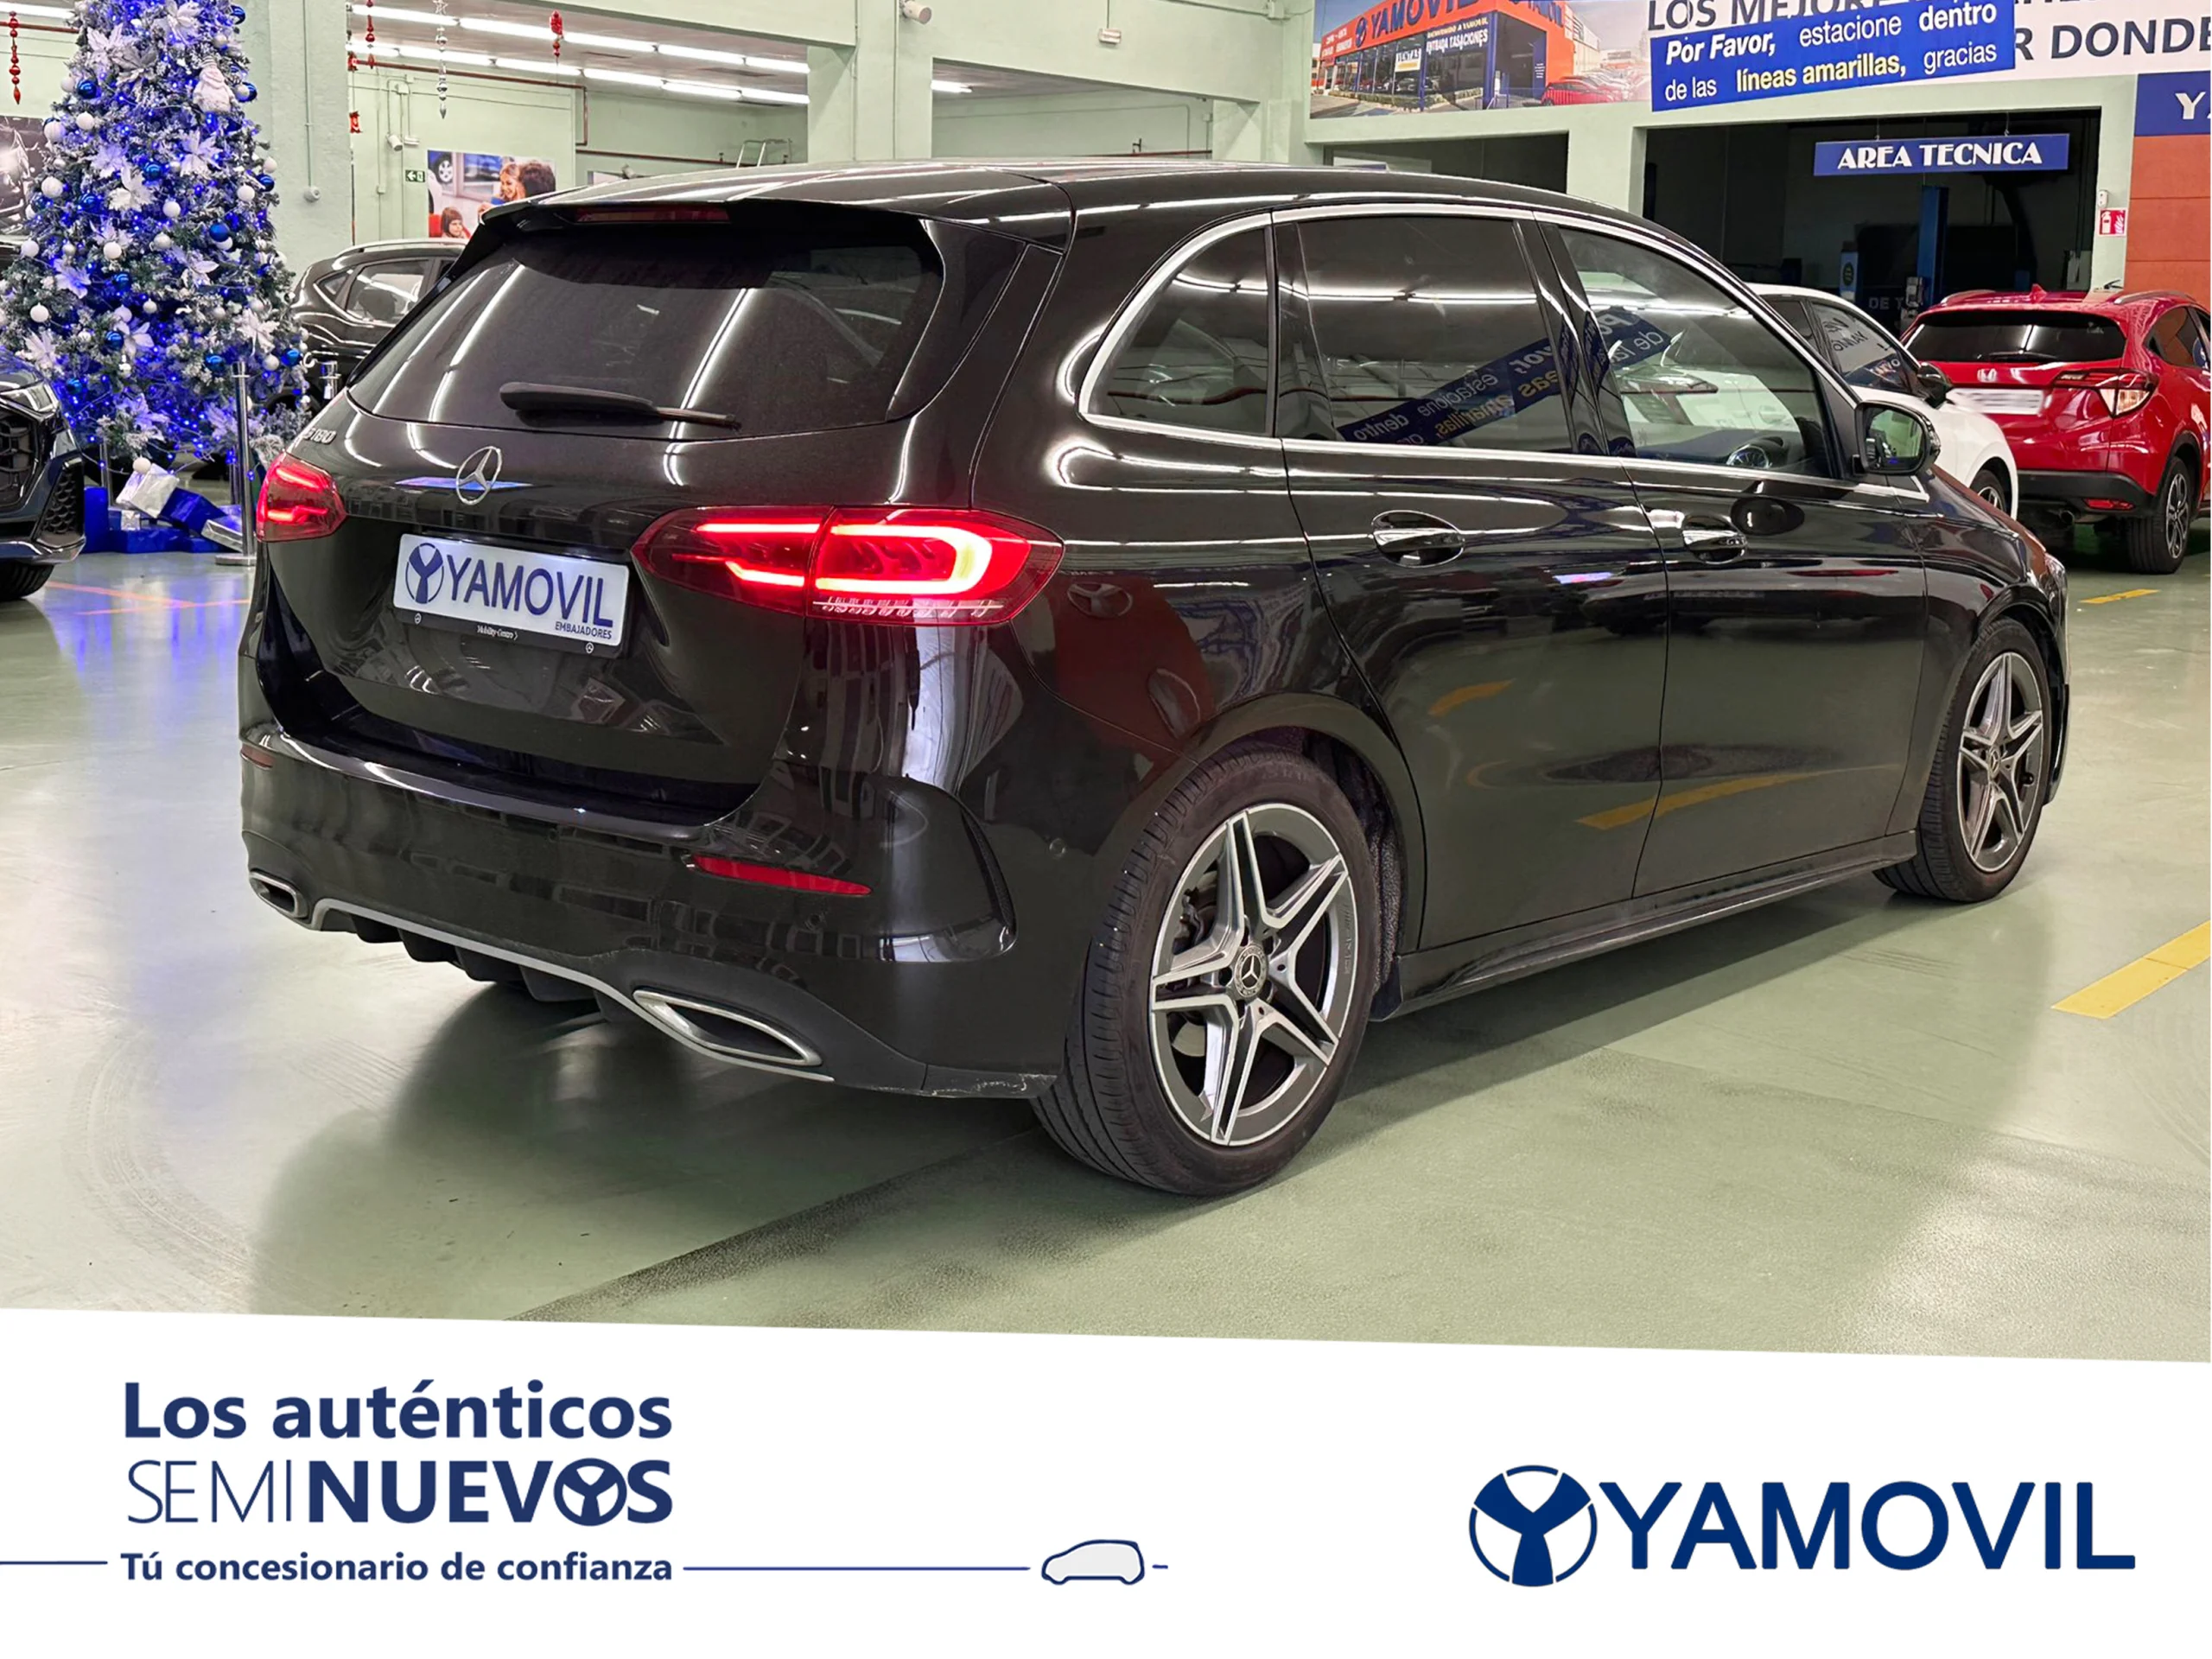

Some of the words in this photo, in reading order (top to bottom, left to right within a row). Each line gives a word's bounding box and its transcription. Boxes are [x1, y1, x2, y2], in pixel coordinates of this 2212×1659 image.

[1370, 0, 1480, 40] YAMOV
[1648, 0, 1717, 31] LOS
[1666, 37, 1707, 66] Por
[1709, 30, 1777, 60] Favor,
[1799, 15, 1902, 48] estacione
[1918, 3, 1998, 32] dentro
[1665, 79, 1688, 101] de
[1692, 76, 1717, 97] las
[1737, 67, 1797, 92] líneas
[1802, 52, 1907, 83] amarillas,
[1923, 41, 1998, 75] gracias
[1837, 145, 1913, 170] AREA
[1918, 142, 2043, 167] TECNICA
[447, 554, 613, 627] YAMOVIL
[555, 620, 613, 639] EMBAJADORES
